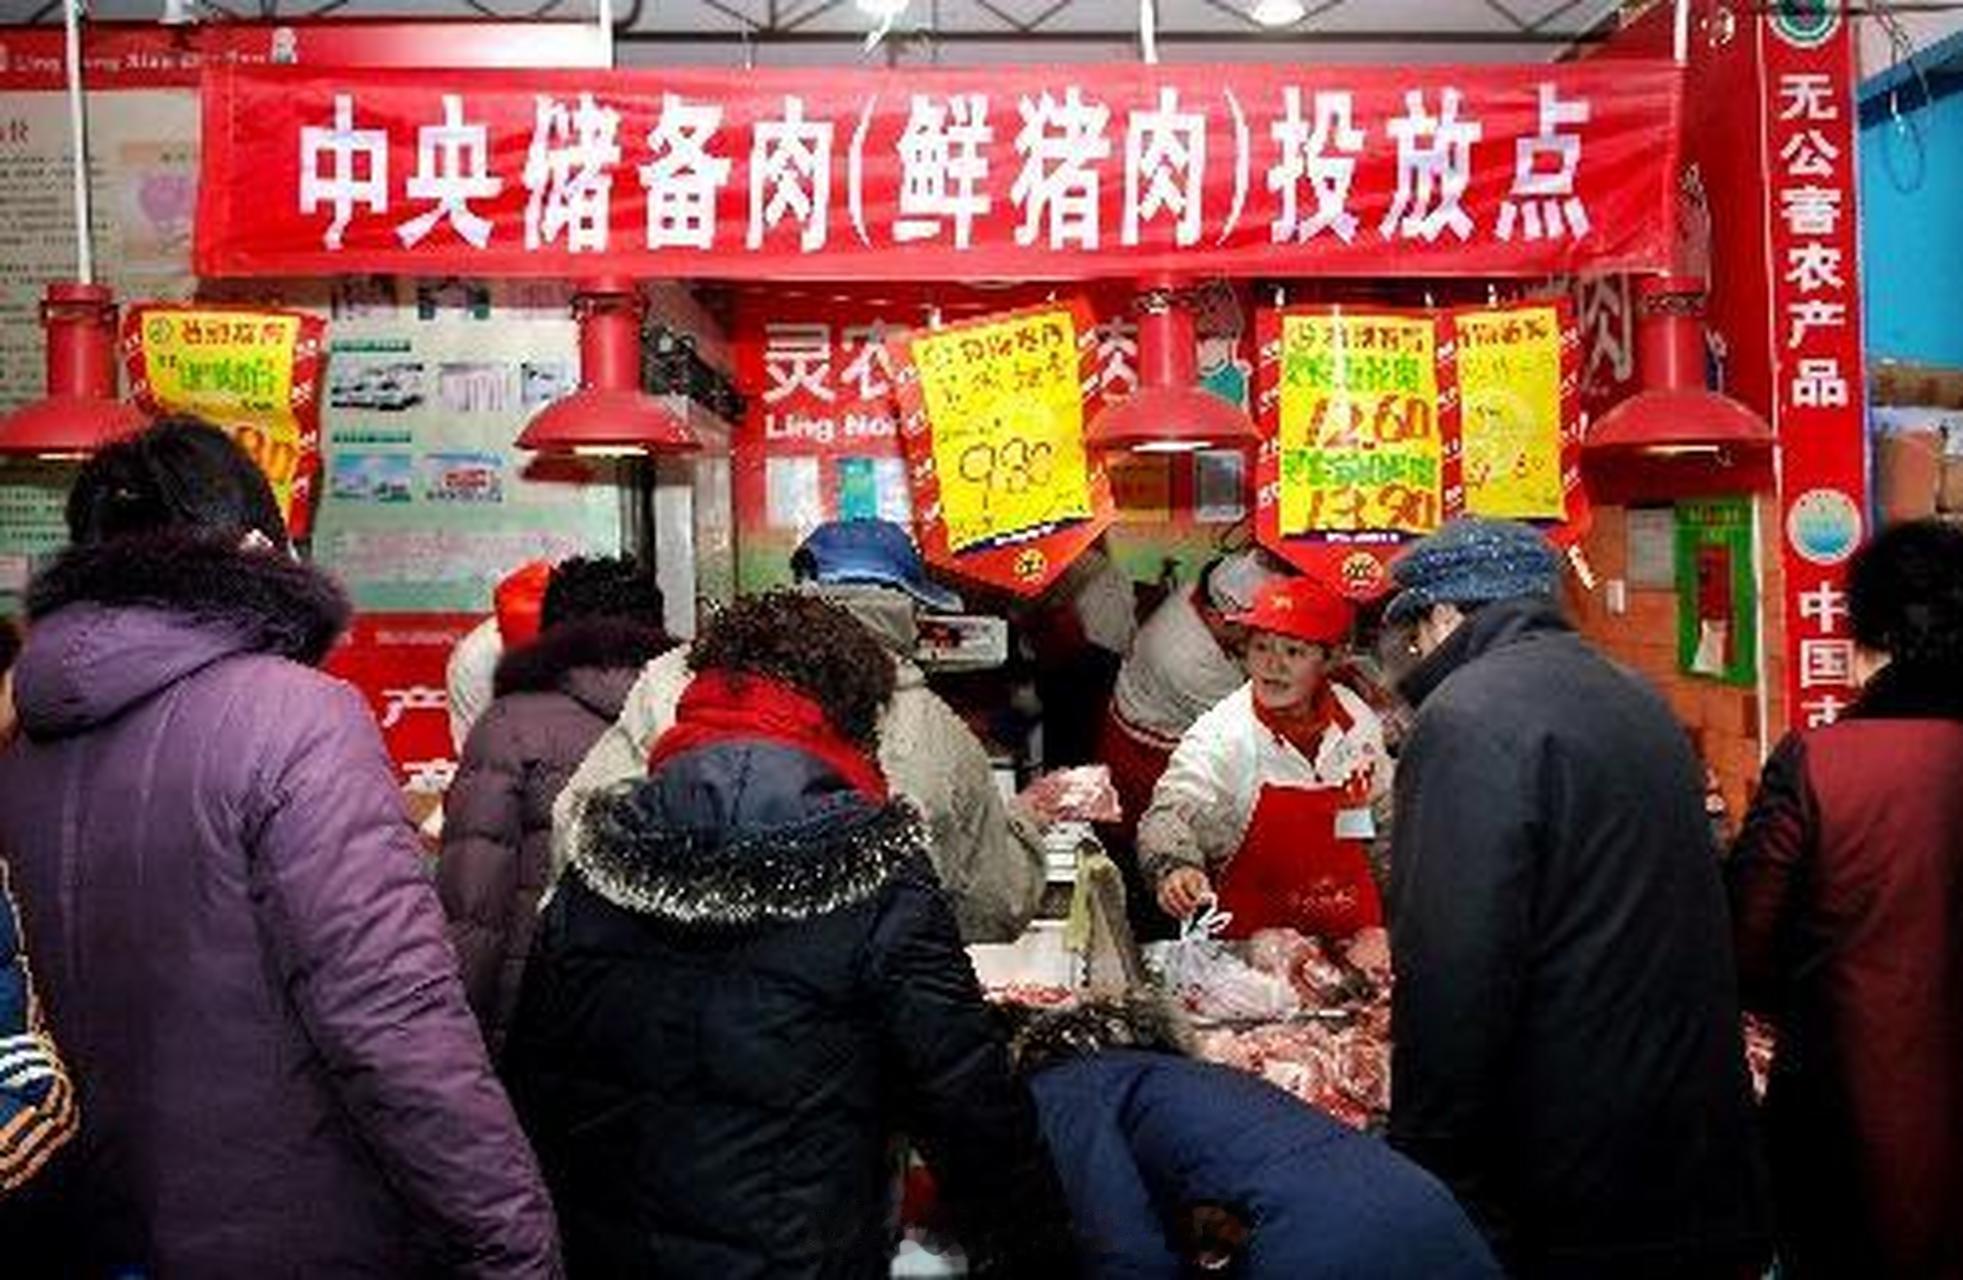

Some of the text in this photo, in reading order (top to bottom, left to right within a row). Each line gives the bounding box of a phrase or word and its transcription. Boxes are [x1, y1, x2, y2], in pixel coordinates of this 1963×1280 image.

[298, 82, 1592, 252] 中央储备肉(鲜猪肉)投放点
[1779, 73, 1849, 408] 无公害农产品
